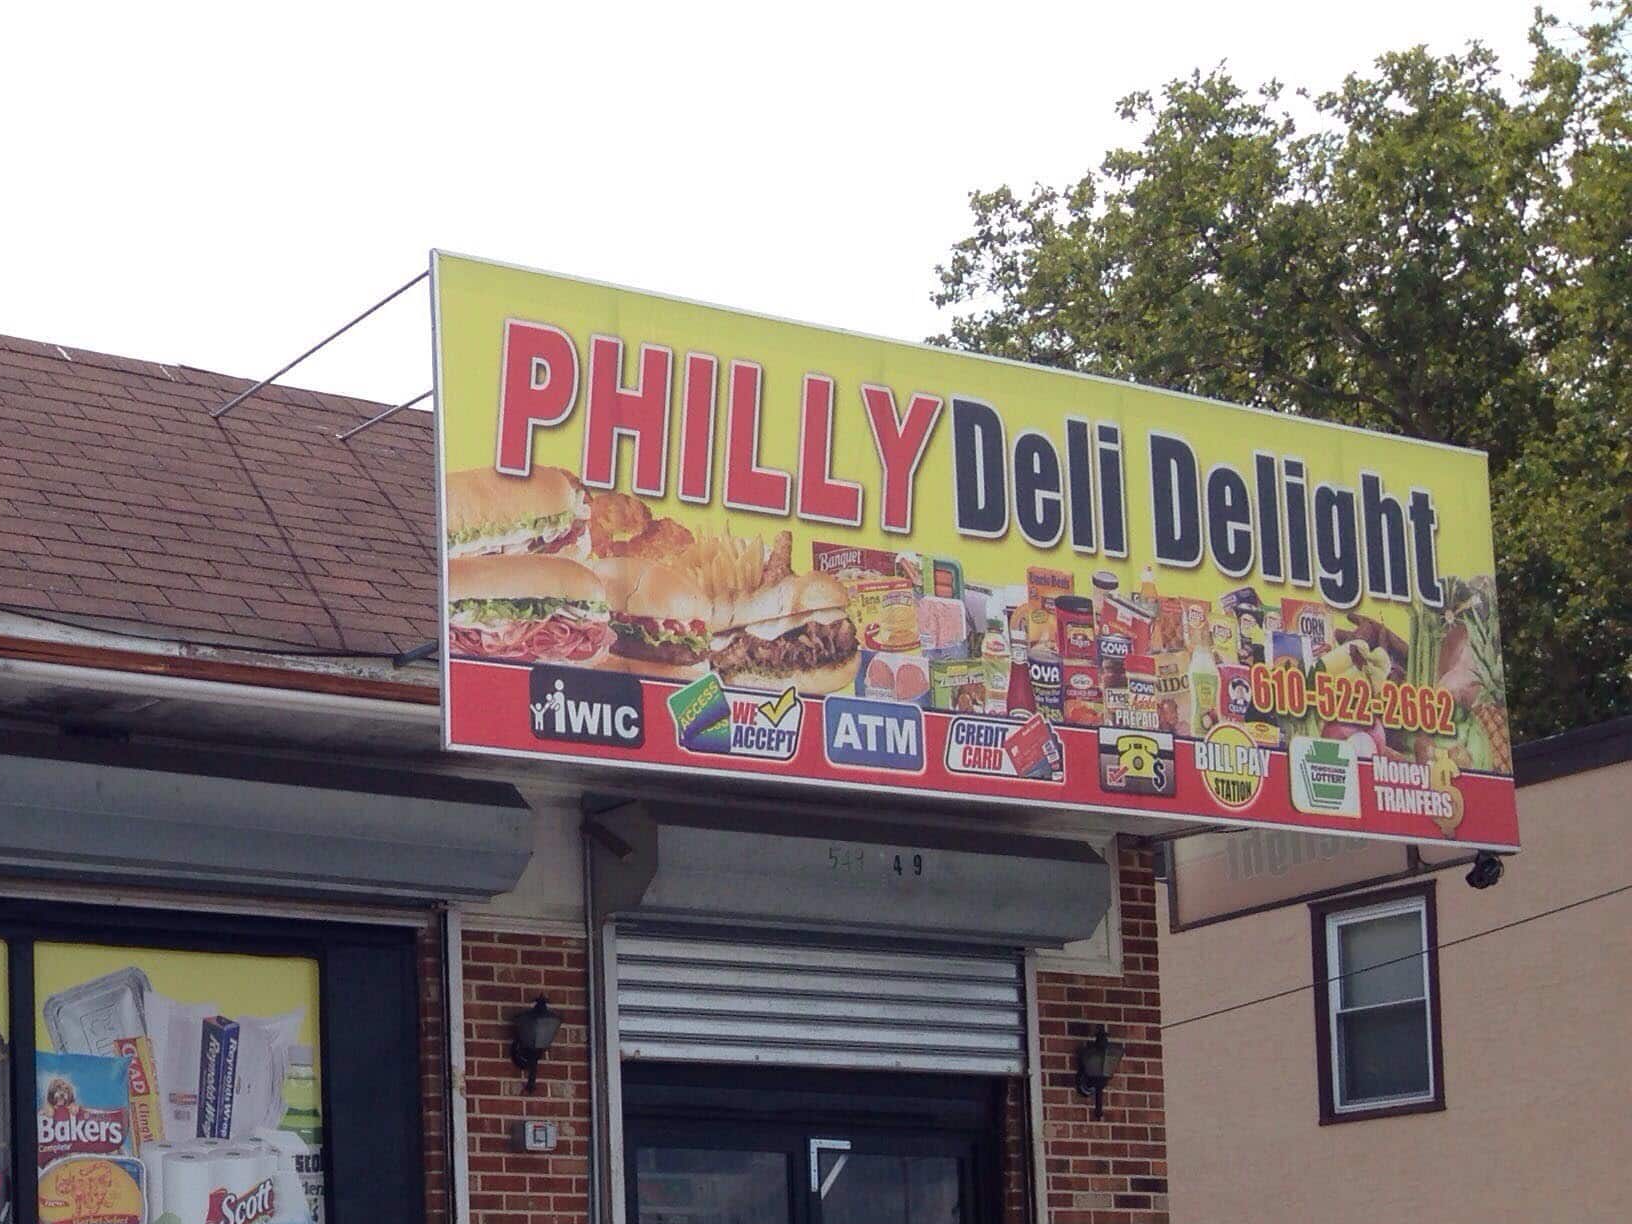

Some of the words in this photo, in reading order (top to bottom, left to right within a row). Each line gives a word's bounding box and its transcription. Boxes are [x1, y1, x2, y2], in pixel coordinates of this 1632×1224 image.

[495, 317, 944, 535] PHILLY
[951, 394, 1128, 559] Deli
[1148, 431, 1444, 610] Delight
[1029, 663, 1060, 683] OYA
[680, 680, 718, 727] ACCESS
[733, 701, 757, 725] WE
[1250, 662, 1456, 736] 610-522-2662
[732, 725, 796, 752] ACCEPT
[833, 712, 918, 756] ATM
[955, 722, 1007, 748] CREDIT
[962, 745, 1004, 771] CARD
[1195, 742, 1235, 772] BILL
[1237, 746, 1270, 777] PAY
[1373, 756, 1431, 789] Money
[1214, 778, 1252, 803] STATION
[1311, 771, 1346, 785] LOTTERY
[1374, 786, 1453, 817] TRANFERS
[225, 1038, 238, 1102] Reynolds
[38, 1115, 123, 1144] Bakers
